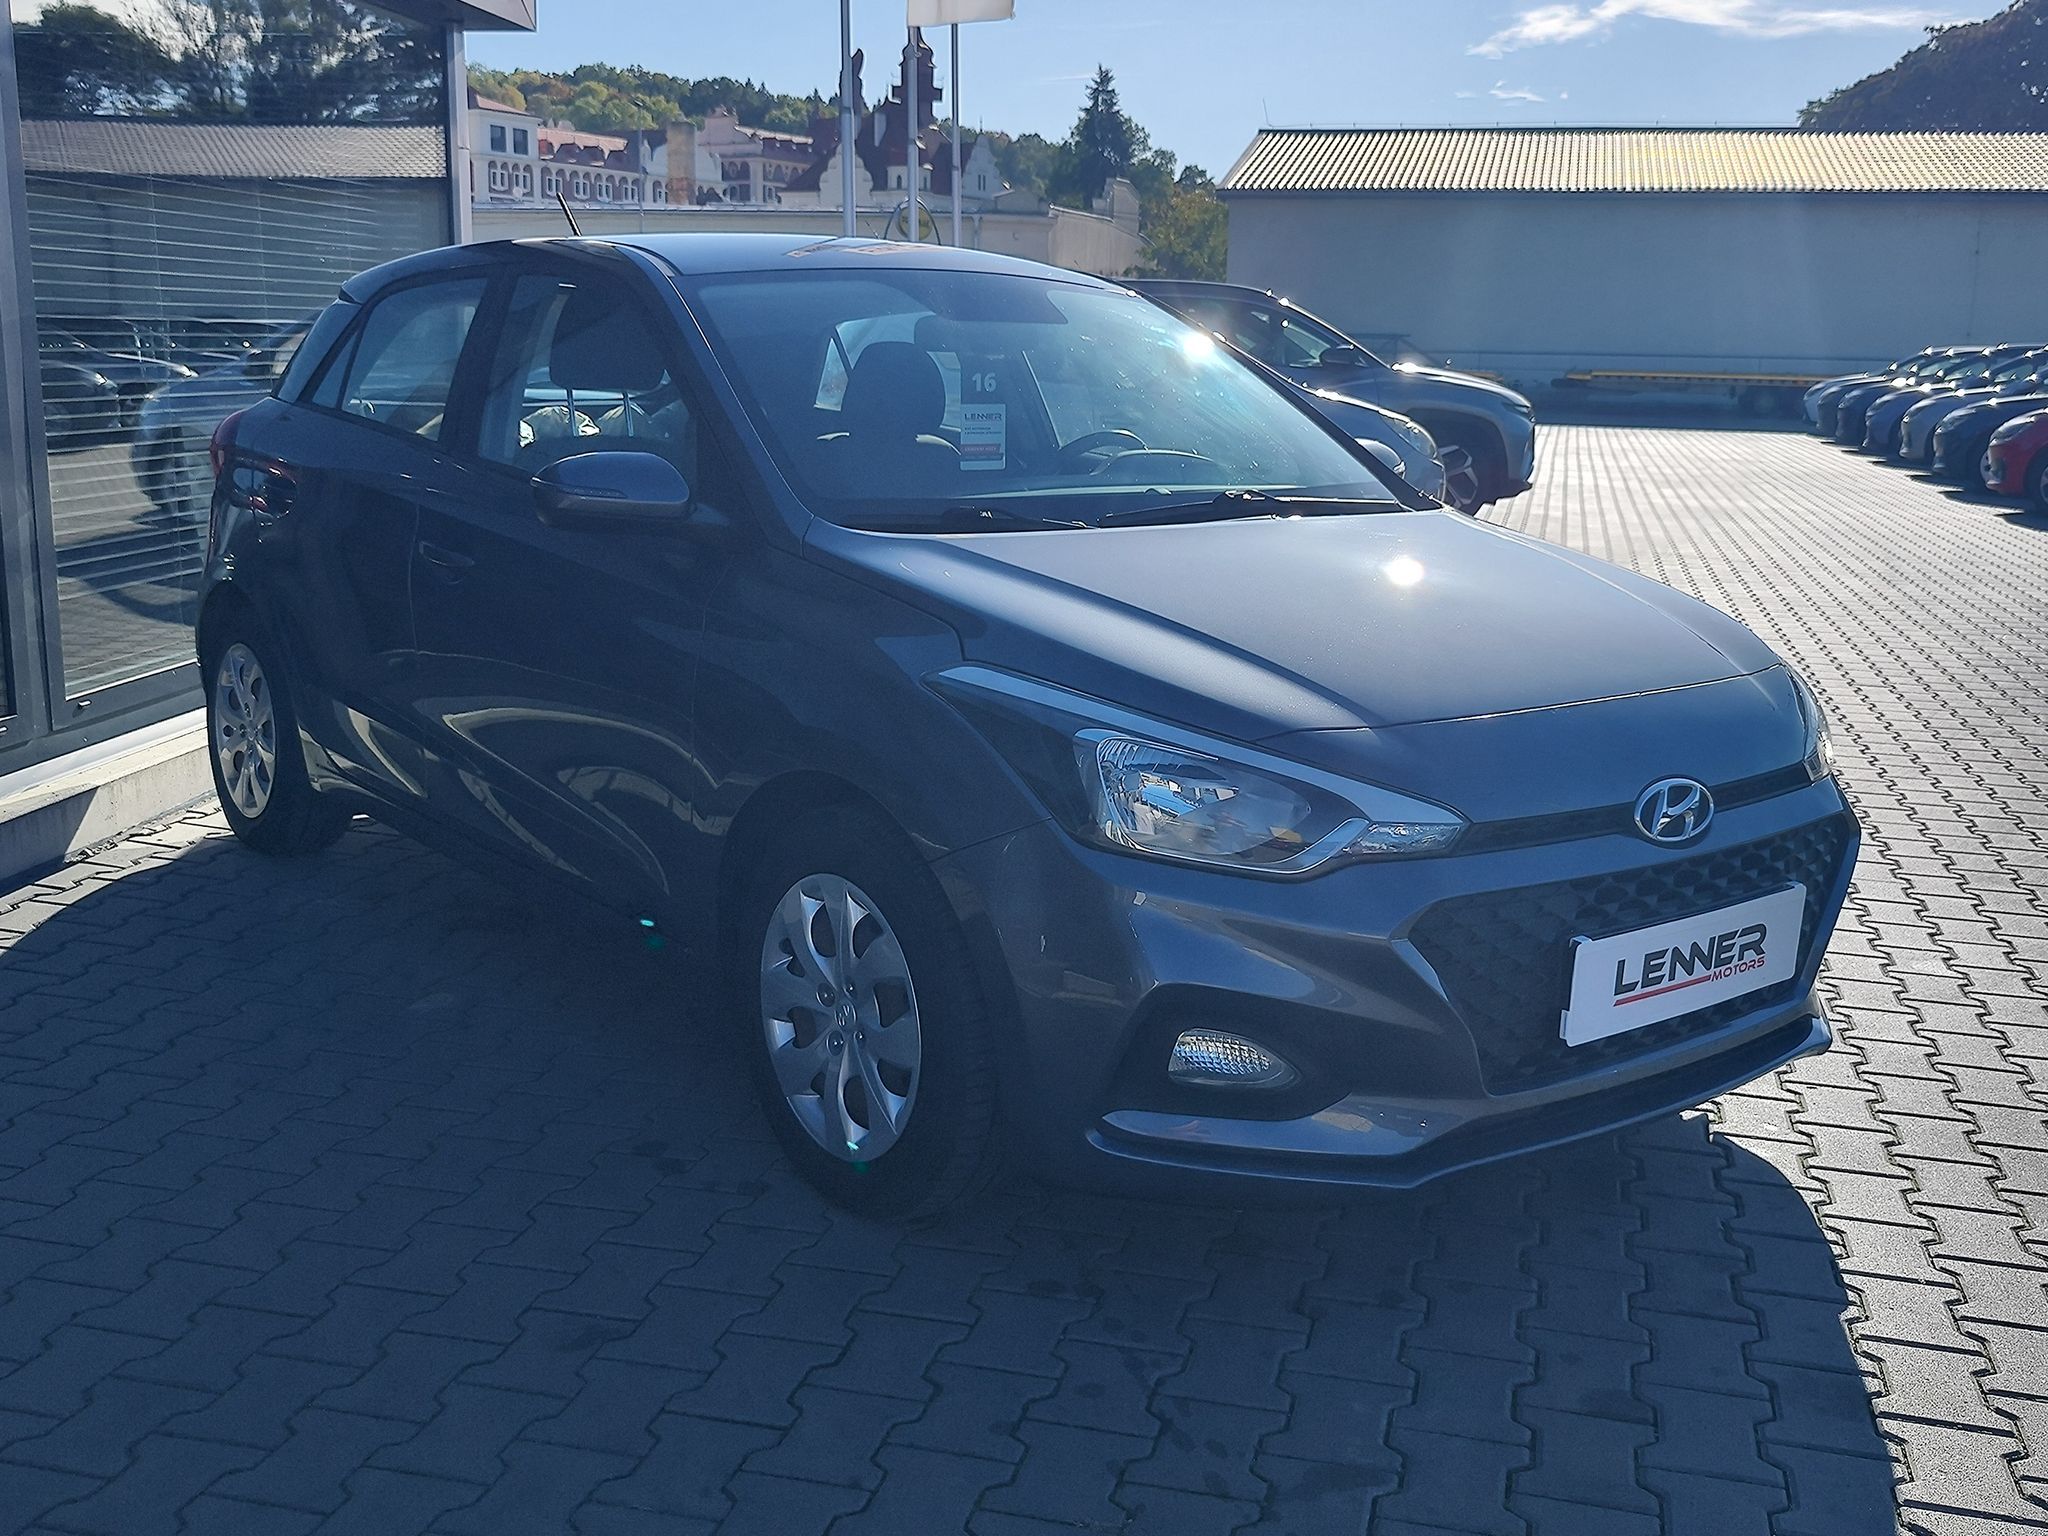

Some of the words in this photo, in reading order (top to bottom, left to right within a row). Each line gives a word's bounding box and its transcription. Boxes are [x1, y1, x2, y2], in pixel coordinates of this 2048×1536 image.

[972, 373, 997, 392] 16
[1613, 923, 1768, 996] LENNER
[1711, 956, 1766, 982] MOTORS
